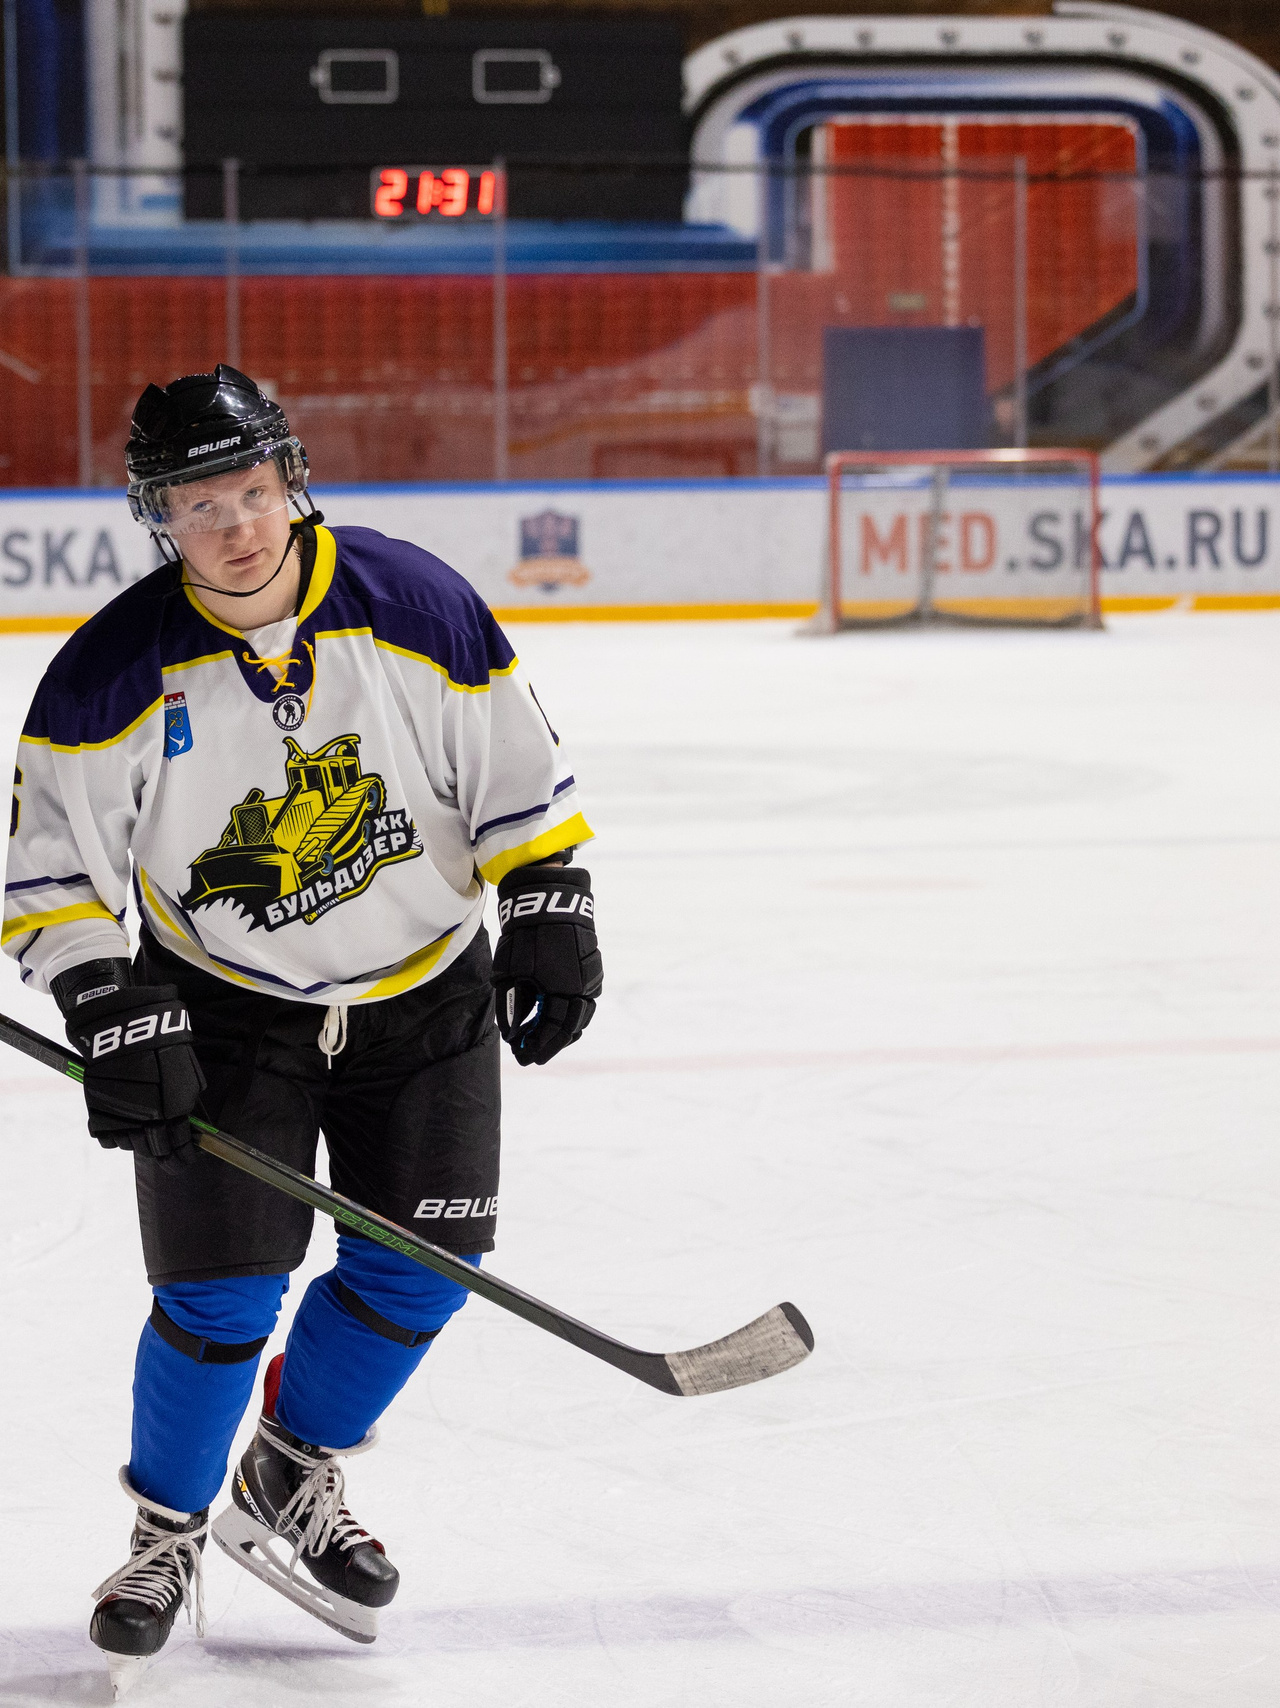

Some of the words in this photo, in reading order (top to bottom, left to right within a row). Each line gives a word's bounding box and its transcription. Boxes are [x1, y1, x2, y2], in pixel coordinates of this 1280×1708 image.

[187, 436, 241, 458] BAUER
[859, 506, 1269, 575] MED.SKA.RU
[373, 813, 405, 834] ХК
[265, 831, 408, 926] БУЛЬДОЗЕР
[81, 985, 116, 1001] BAUER
[92, 1009, 192, 1059] BAU
[333, 1204, 419, 1256] CCM
